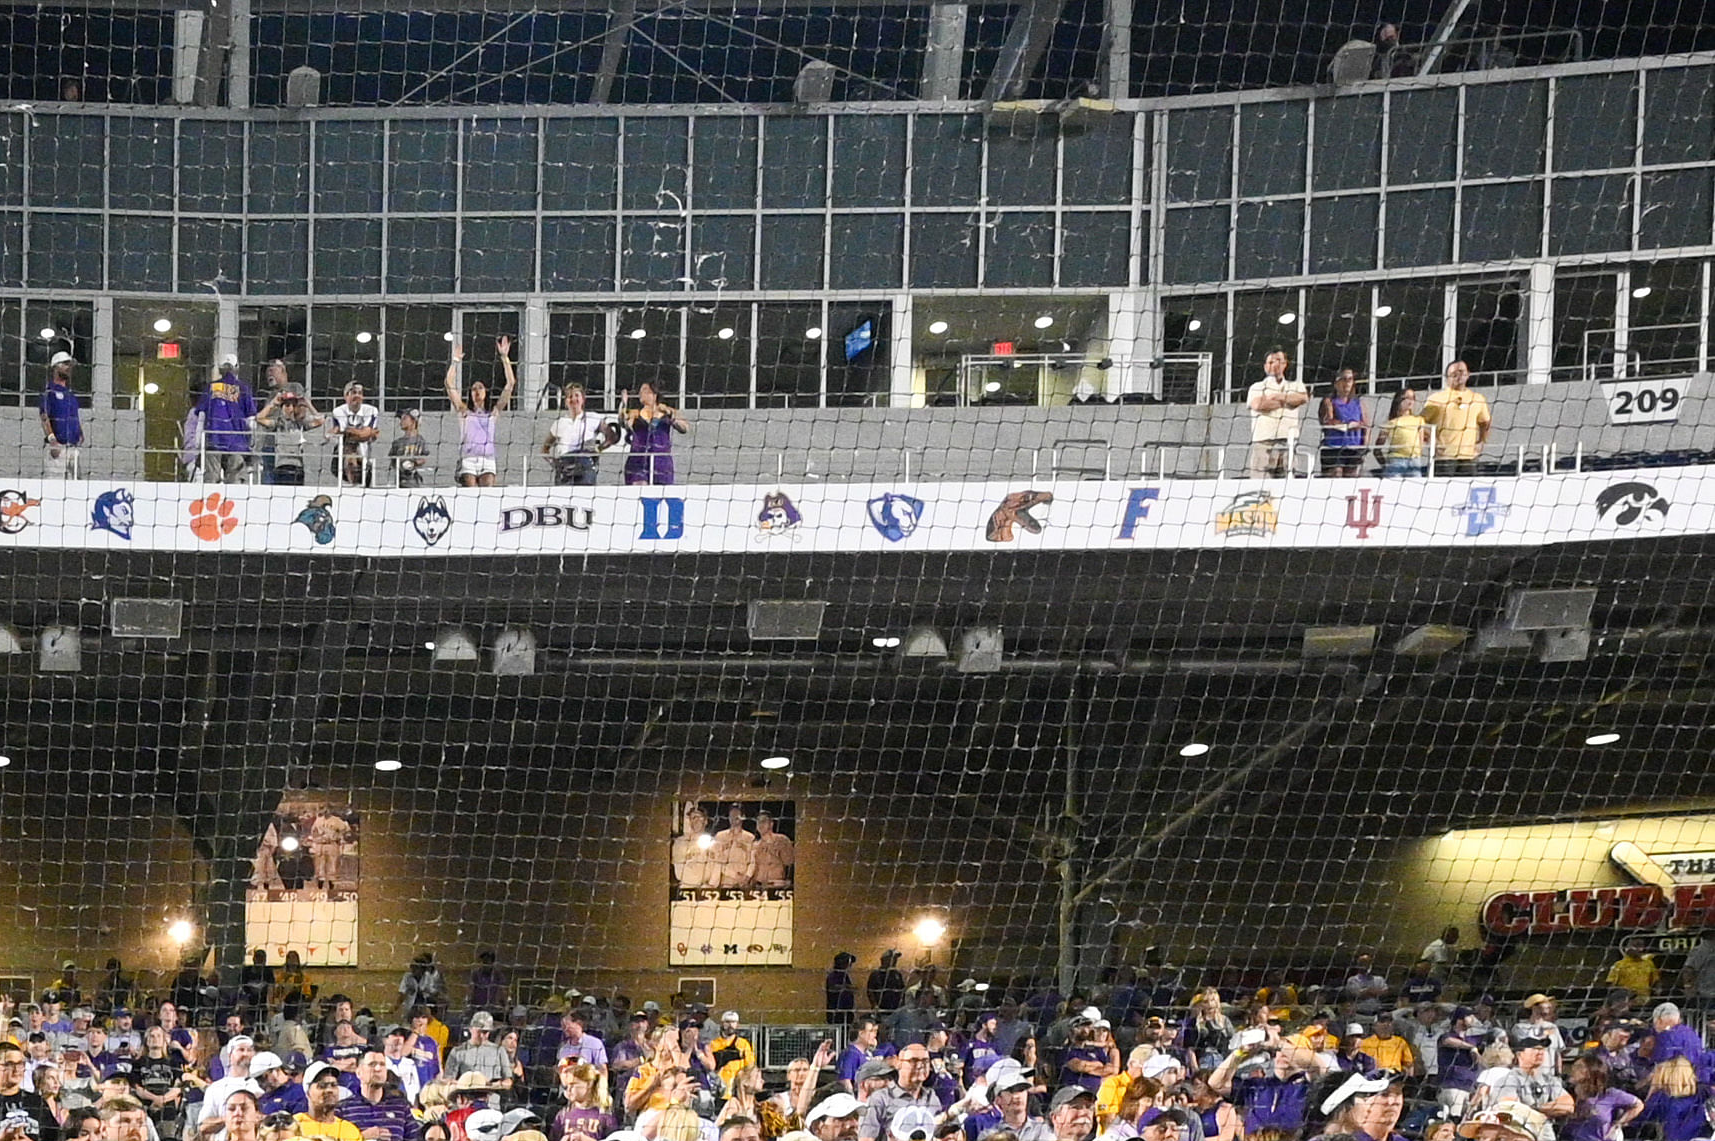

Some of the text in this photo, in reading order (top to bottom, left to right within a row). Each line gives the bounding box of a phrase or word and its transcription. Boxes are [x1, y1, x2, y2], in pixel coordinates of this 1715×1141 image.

[1614, 389, 1679, 417] 209
[500, 504, 593, 532] DBU
[1114, 487, 1161, 540] F
[564, 1118, 600, 1133] LSU
